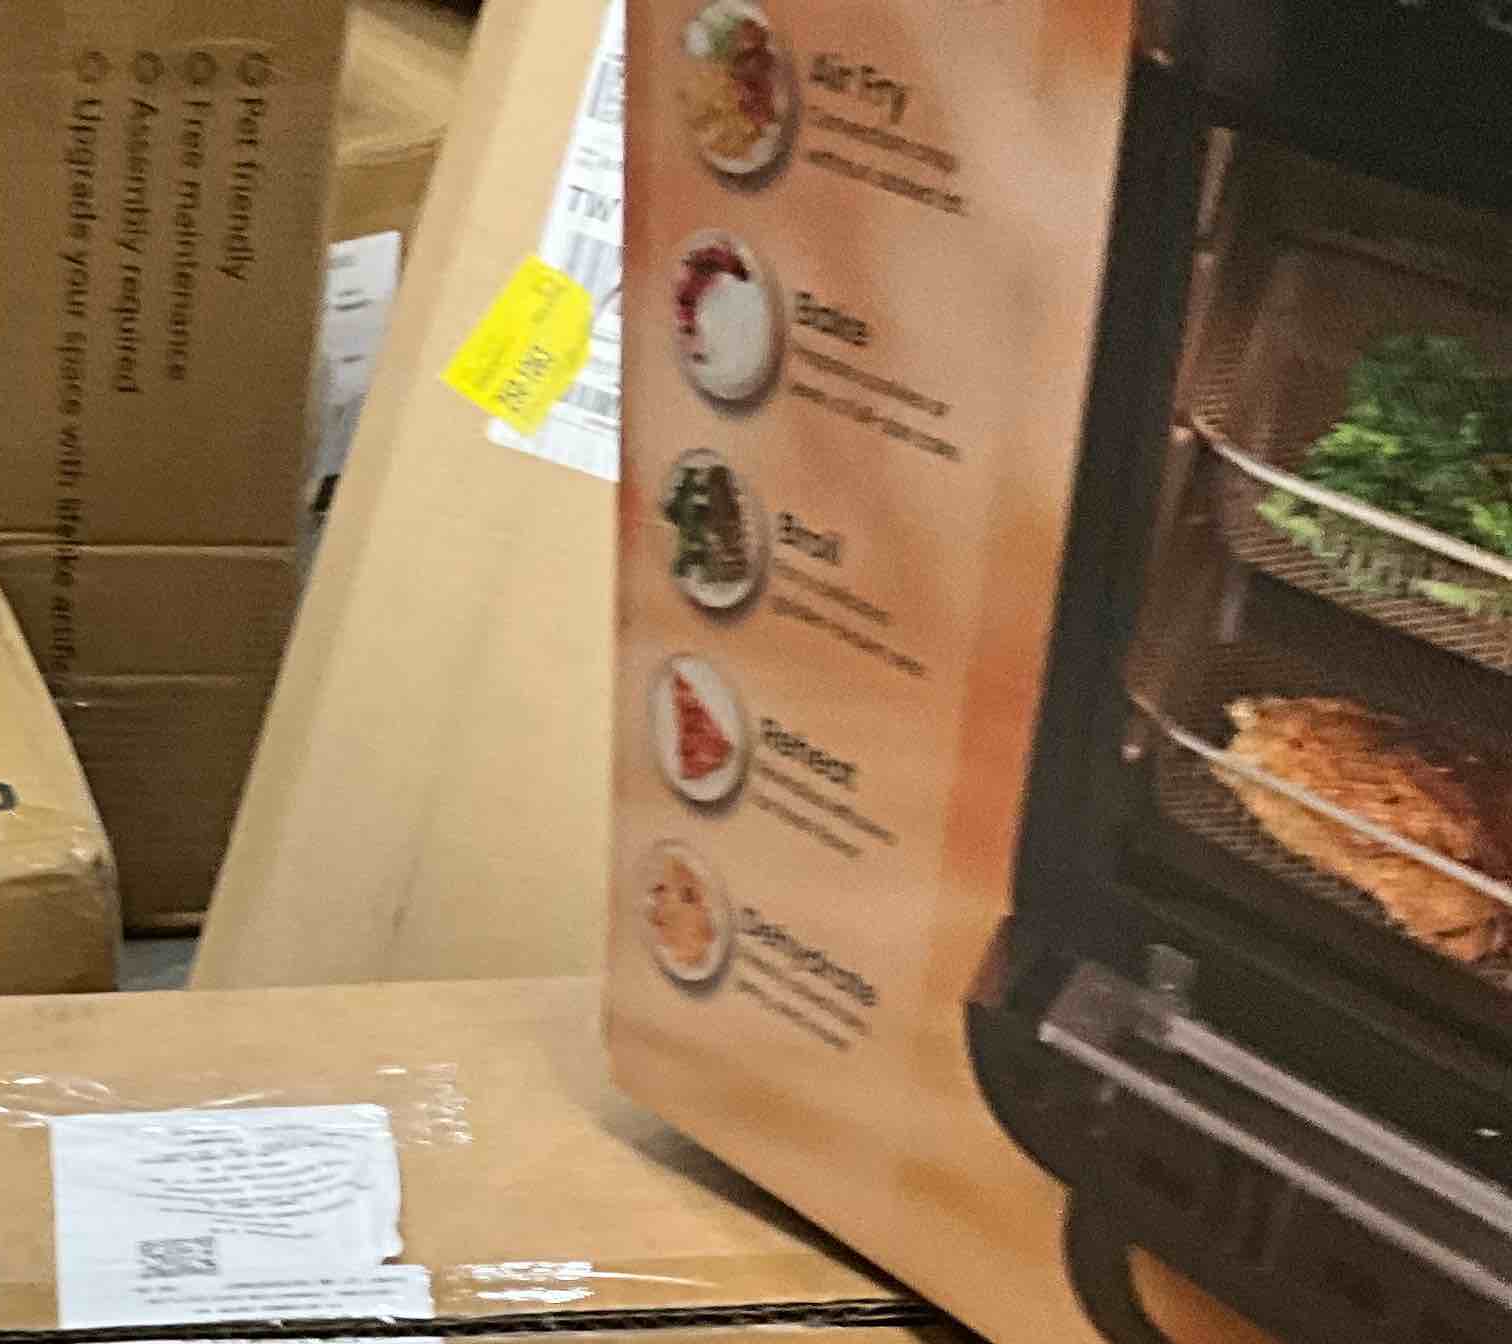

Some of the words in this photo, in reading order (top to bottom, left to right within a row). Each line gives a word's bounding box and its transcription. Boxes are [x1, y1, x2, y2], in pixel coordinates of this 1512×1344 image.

[180, 98, 210, 169] Free
[233, 97, 266, 151] Pet
[859, 64, 908, 126] Fry
[65, 98, 105, 241] Upgrade
[118, 98, 157, 254] Assembly
[217, 161, 261, 283] friendly
[56, 250, 91, 318] your
[167, 180, 203, 382] maintenance
[110, 264, 148, 395] required
[54, 331, 86, 416] space
[57, 425, 86, 487] with
